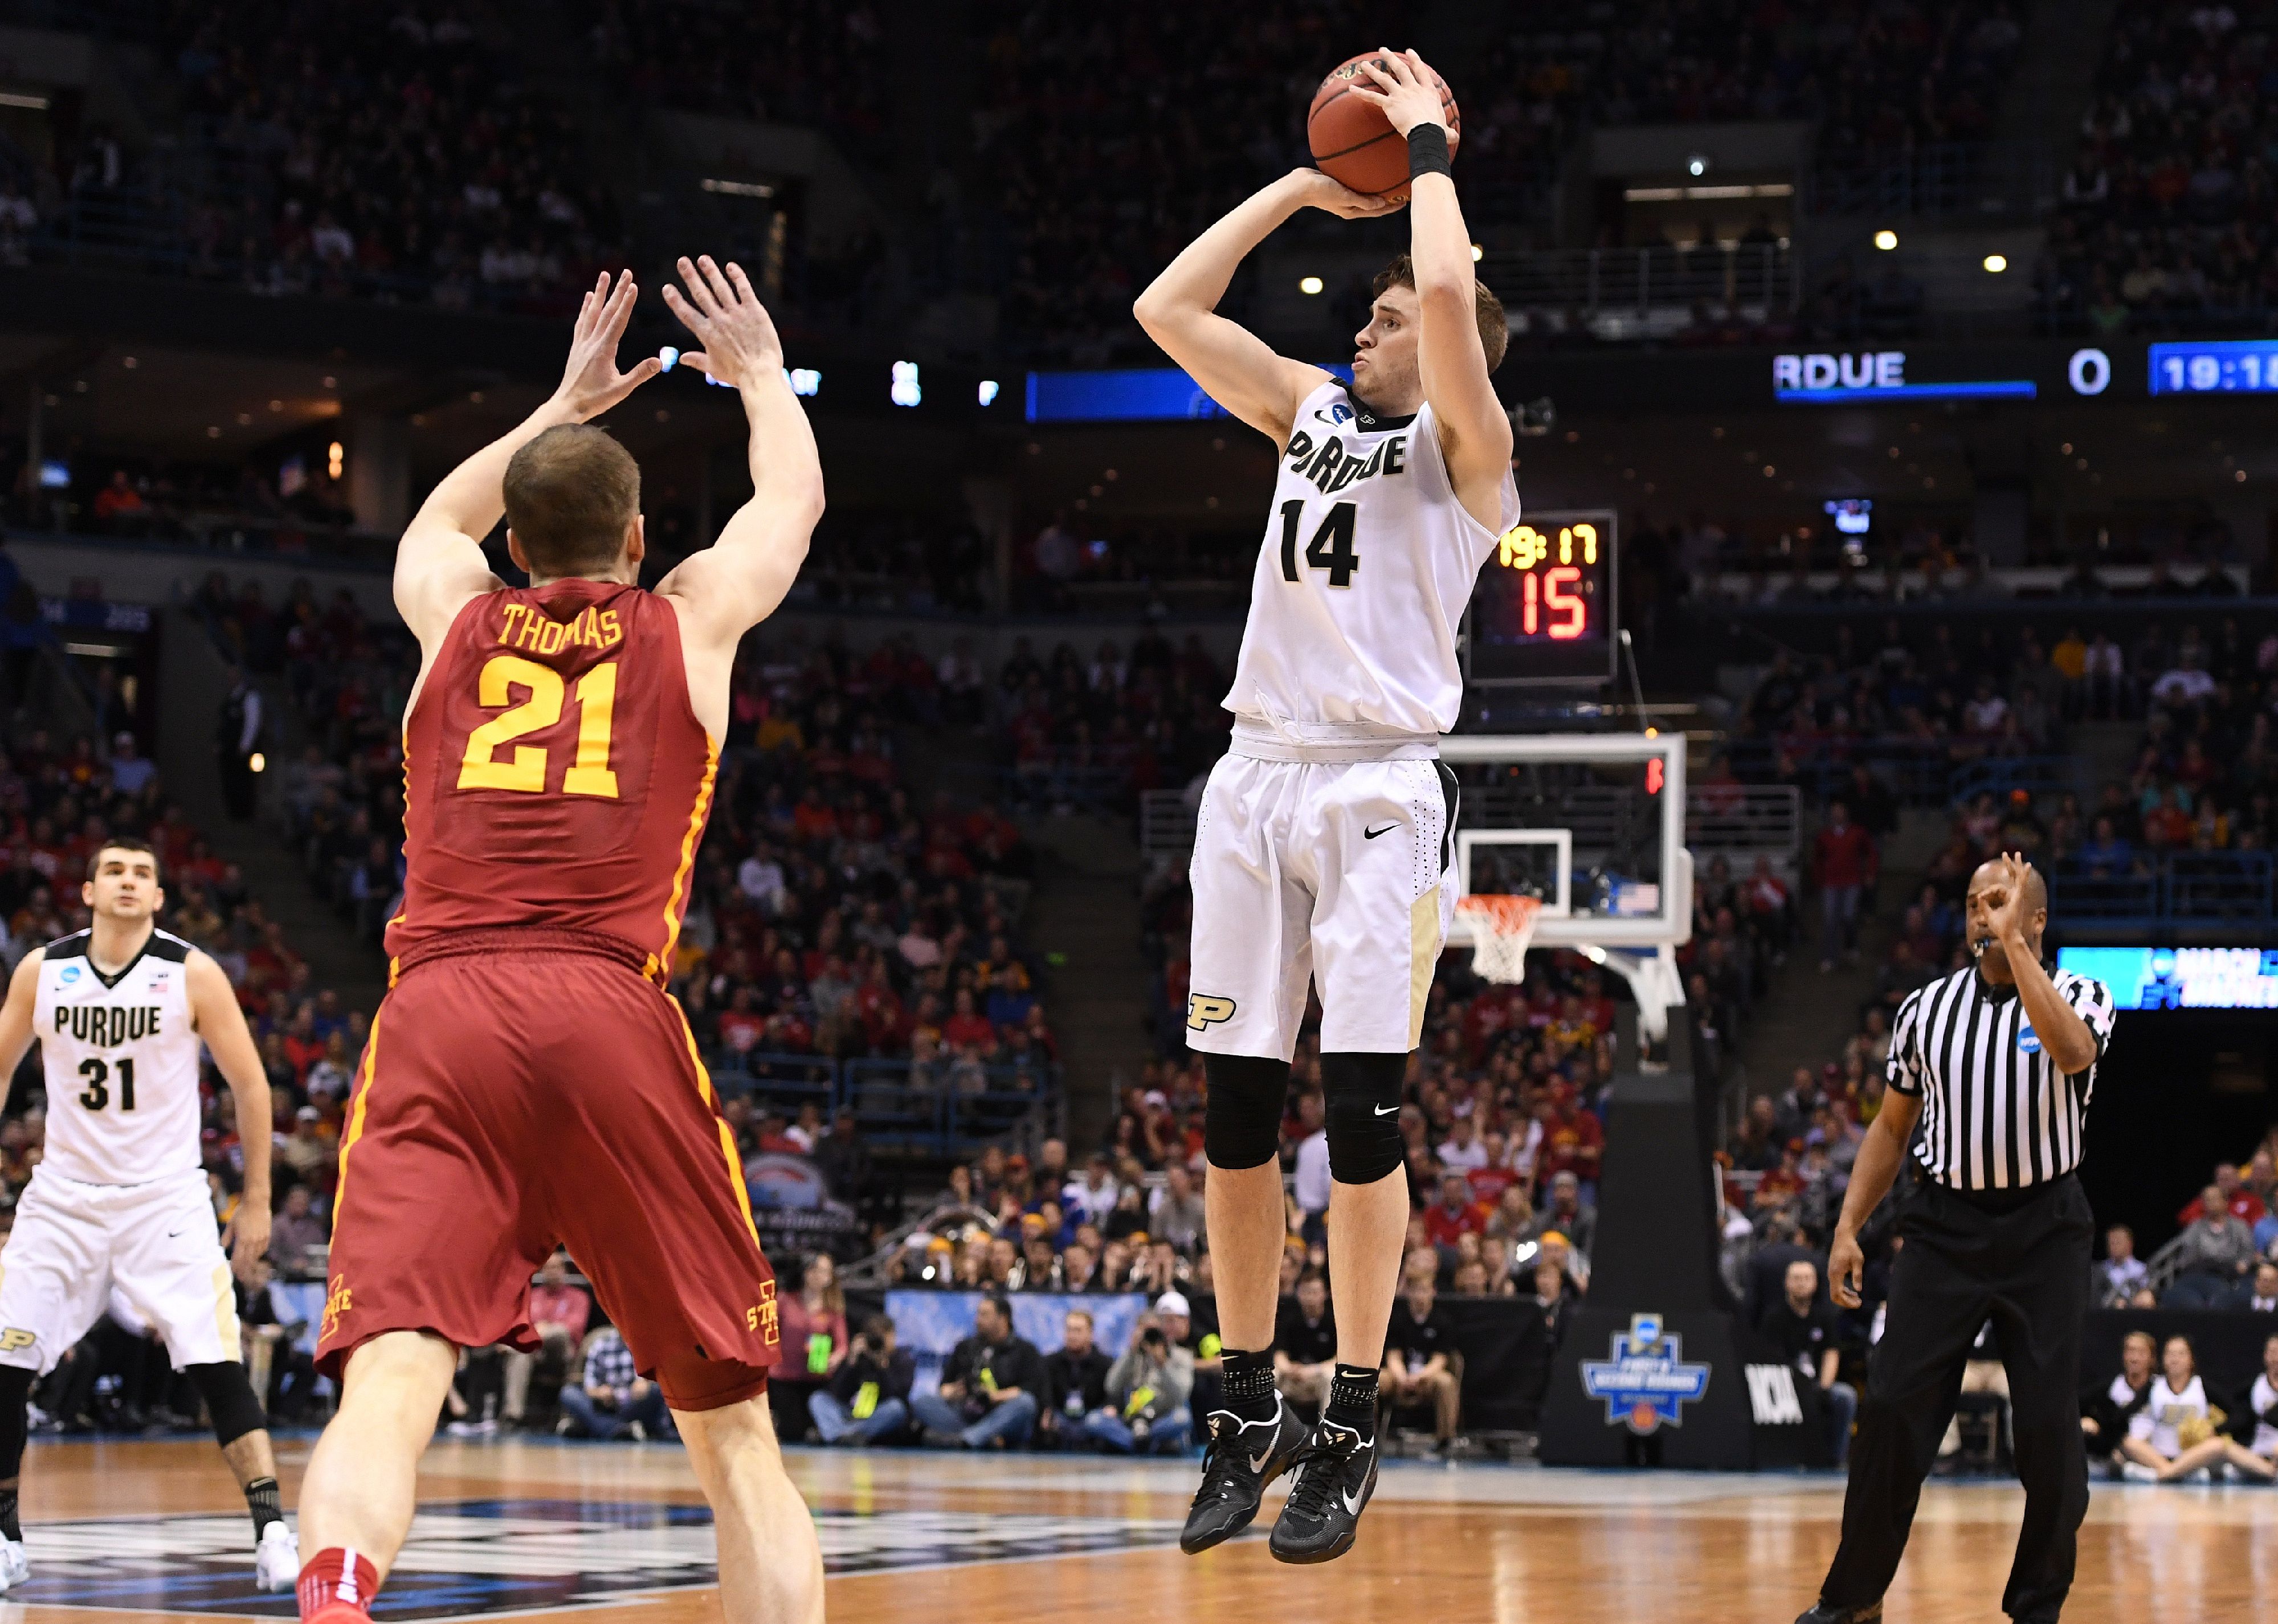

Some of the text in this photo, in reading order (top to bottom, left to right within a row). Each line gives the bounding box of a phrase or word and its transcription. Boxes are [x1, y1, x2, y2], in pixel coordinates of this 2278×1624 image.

[1287, 430, 1409, 495] PURDUE
[1279, 500, 1360, 589] 14
[1500, 524, 1597, 569] 19:17
[497, 603, 622, 654] THOMAS
[1524, 567, 1585, 640] 15
[457, 655, 619, 798] 21
[54, 1005, 161, 1048] PURDUE
[1187, 993, 1236, 1032] P
[78, 1056, 134, 1112] 31
